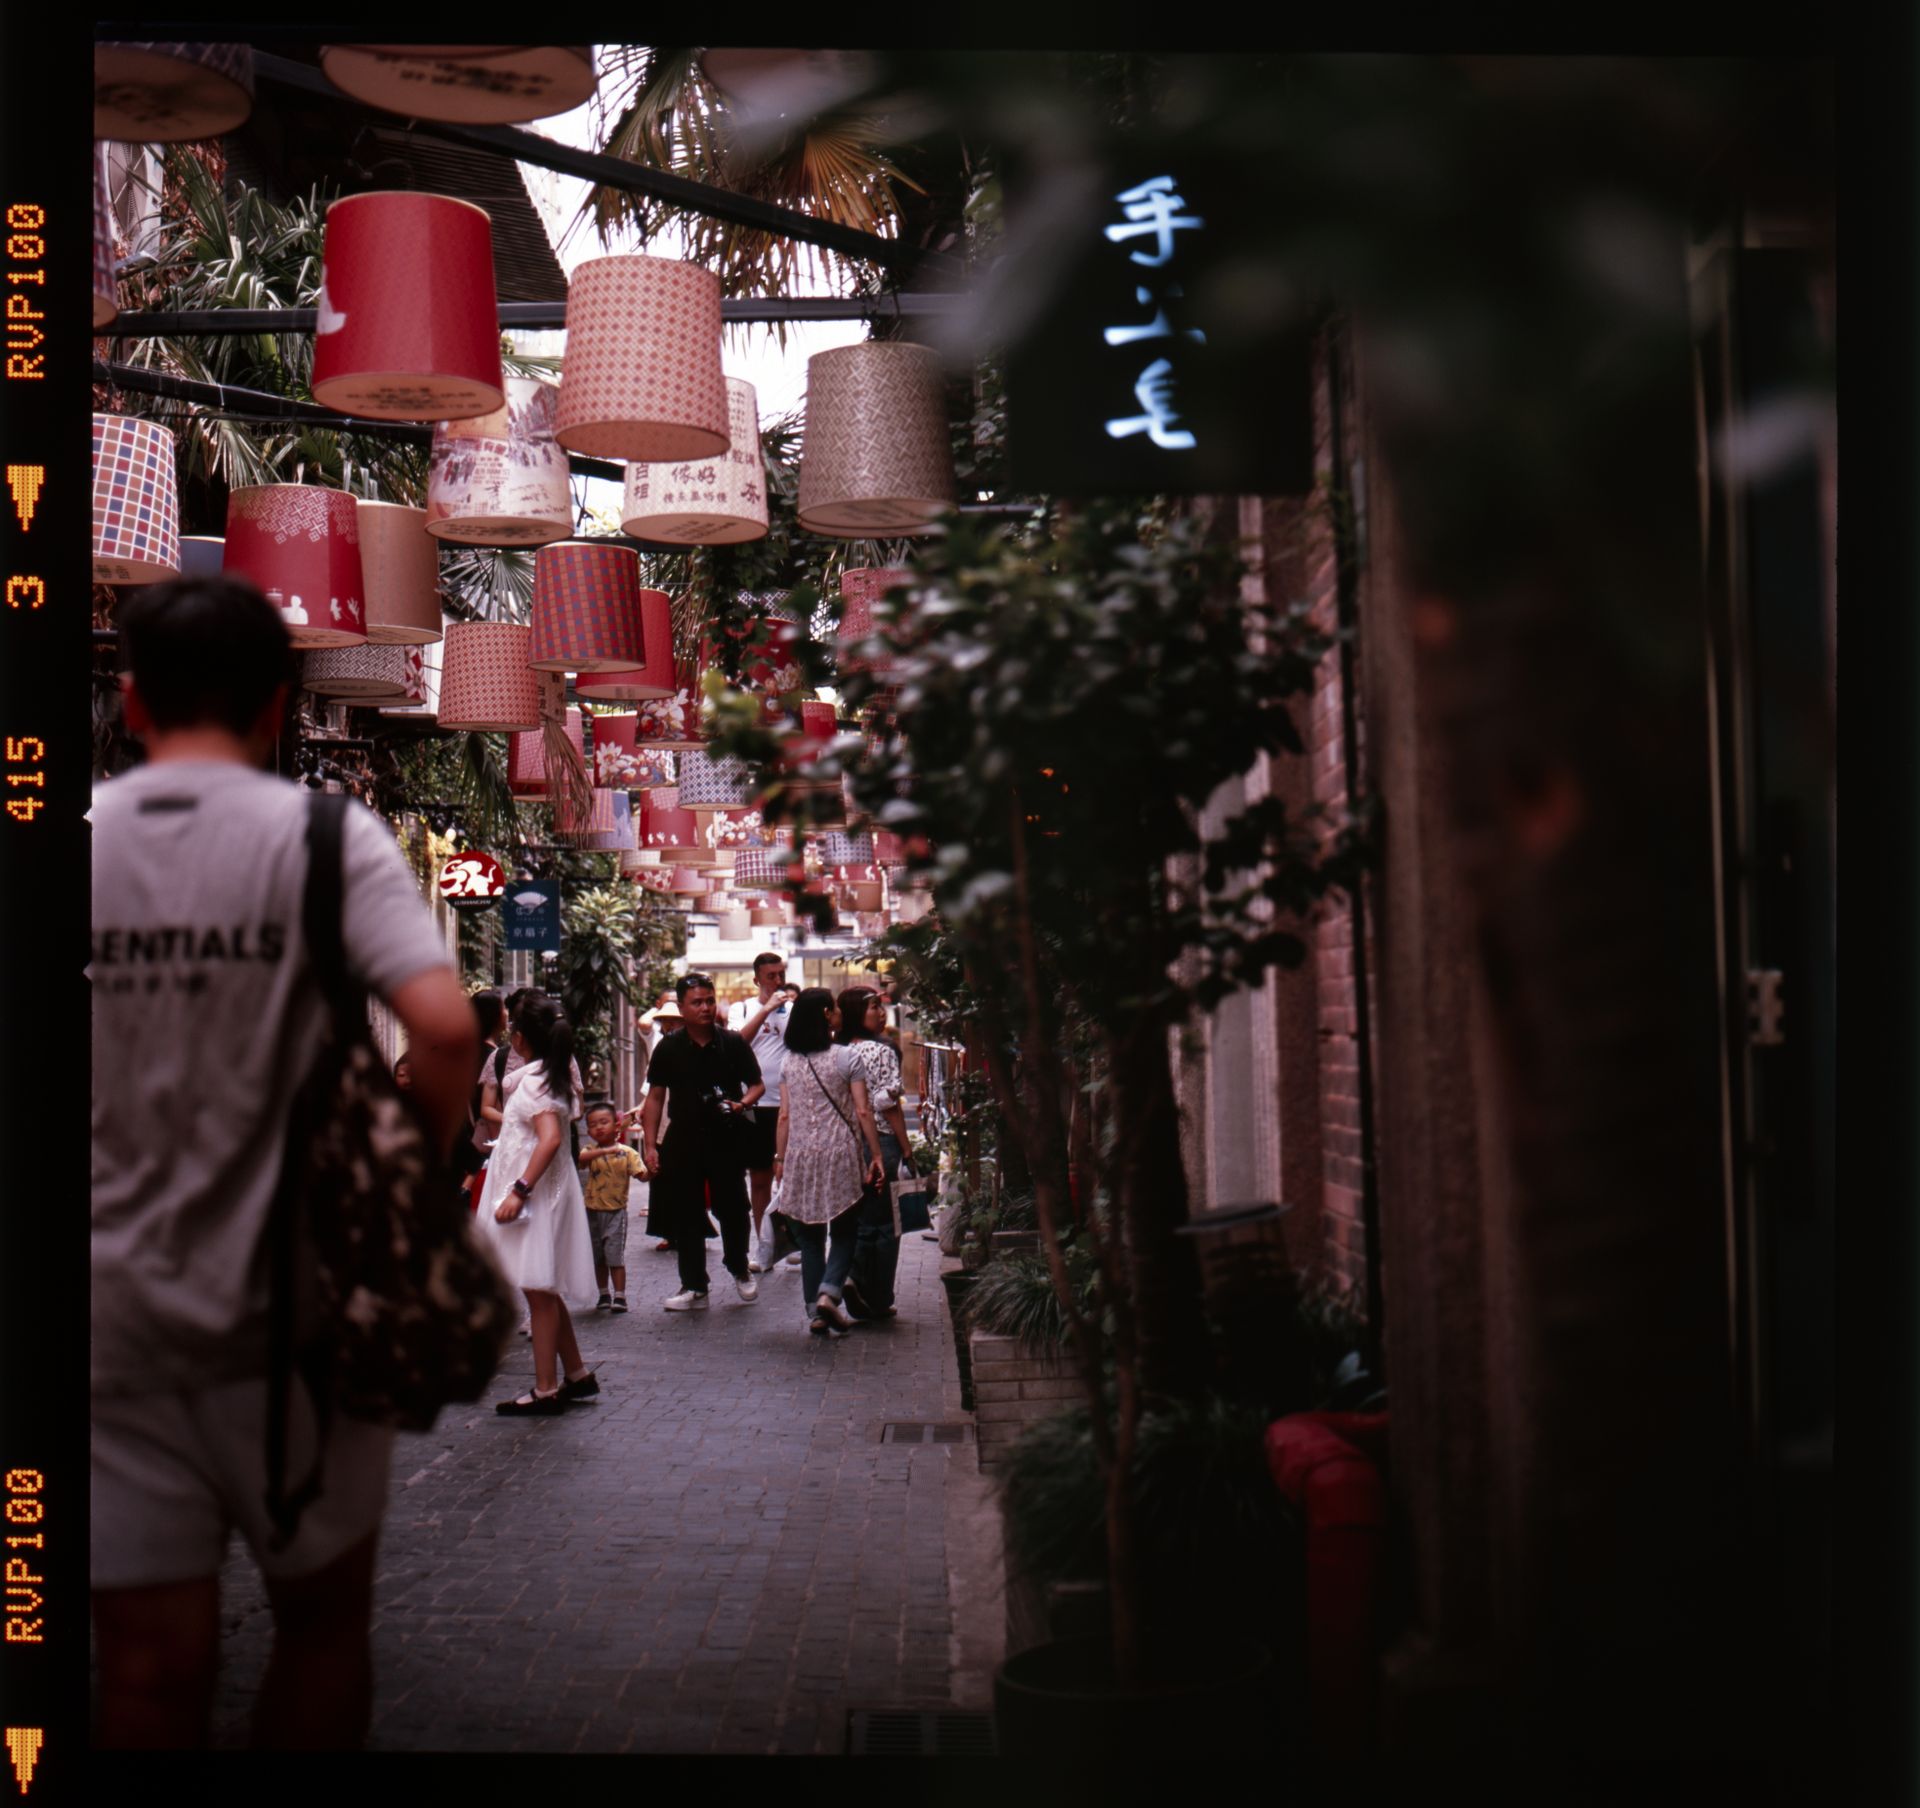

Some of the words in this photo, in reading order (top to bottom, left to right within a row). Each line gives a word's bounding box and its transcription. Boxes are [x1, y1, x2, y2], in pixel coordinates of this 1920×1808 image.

[6, 203, 45, 379] RVP100
[6, 575, 45, 608] 3
[5, 736, 45, 820] 415
[5, 1468, 44, 1642] RVP100
